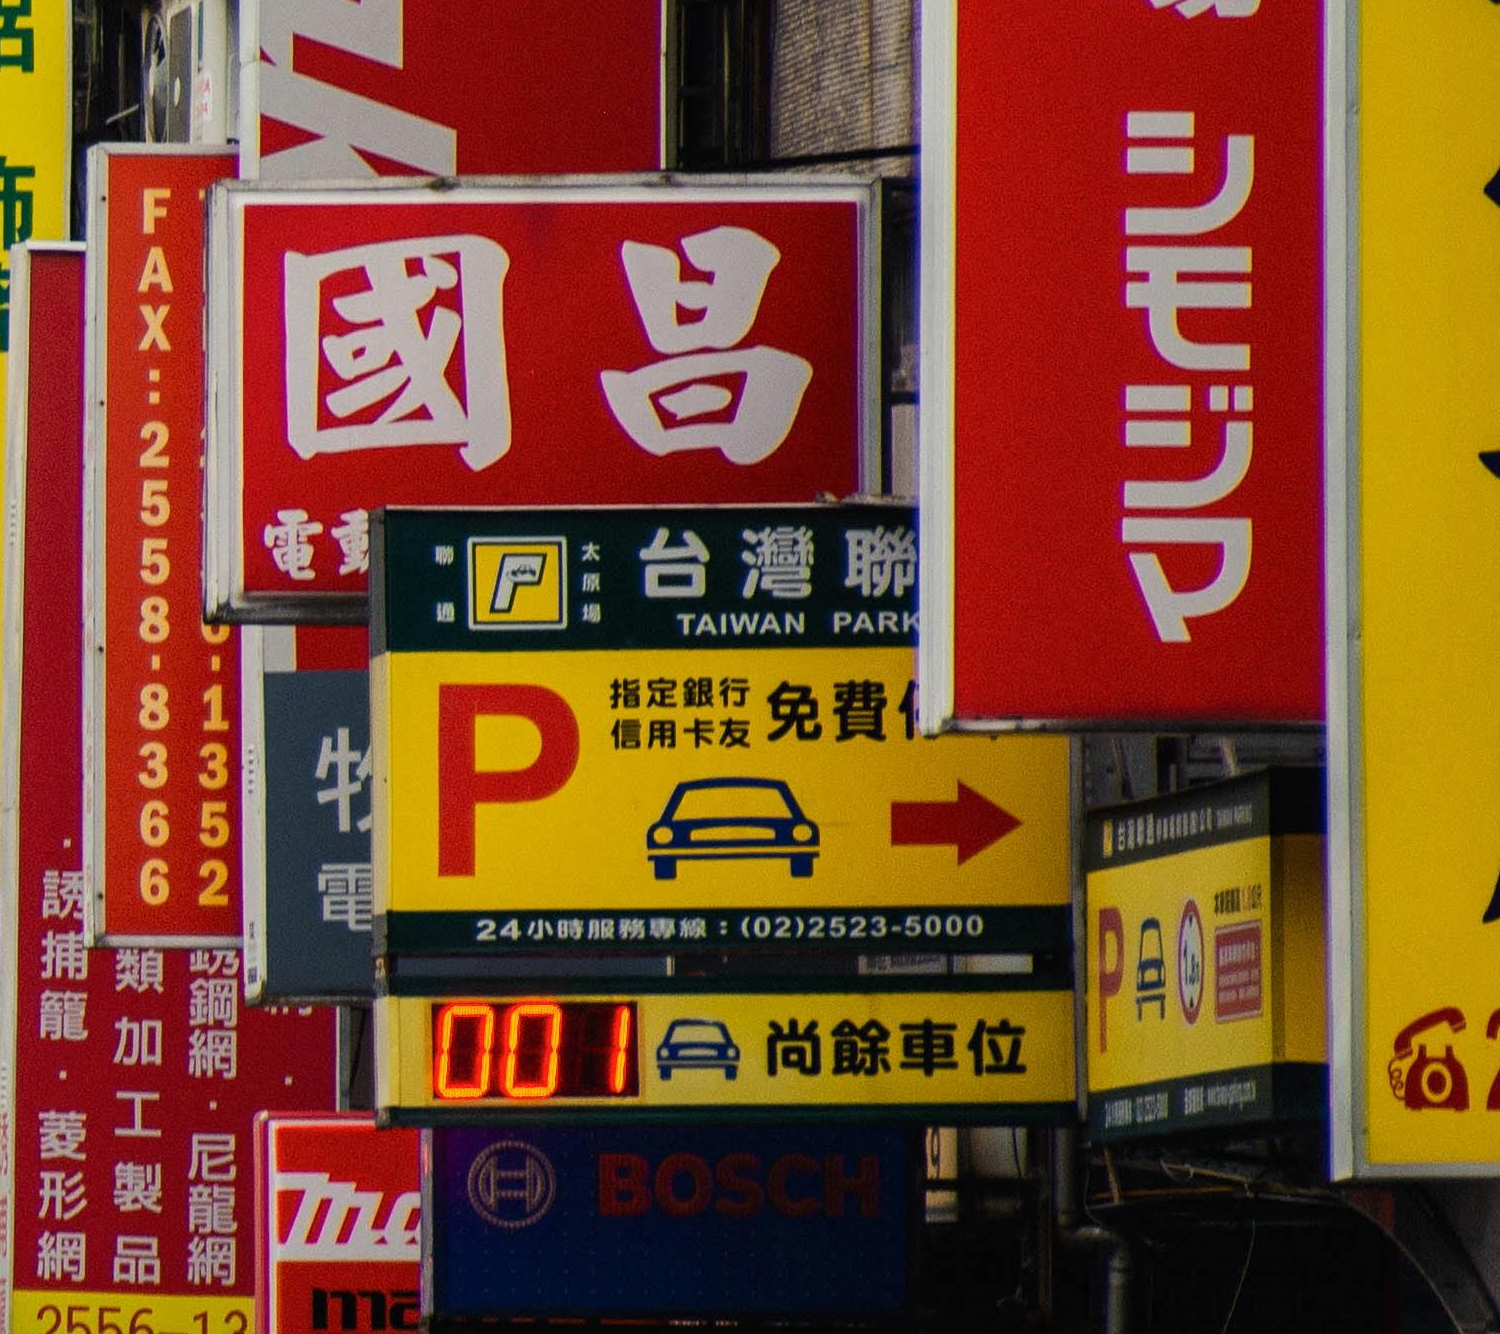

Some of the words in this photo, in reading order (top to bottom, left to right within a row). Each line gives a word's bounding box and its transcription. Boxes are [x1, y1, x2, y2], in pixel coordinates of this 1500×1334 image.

[1120, 109, 1258, 644] シモジマ
[676, 611, 806, 637] TAIWAN
[609, 676, 751, 710] 指定銀行
[610, 717, 752, 751] 信用卡友
[437, 682, 582, 879] P
[739, 911, 986, 941] (02)2523-5000
[435, 1002, 632, 1100] 001
[765, 1018, 1028, 1079] 尚餘車位
[598, 1152, 881, 1220] BOSCH
